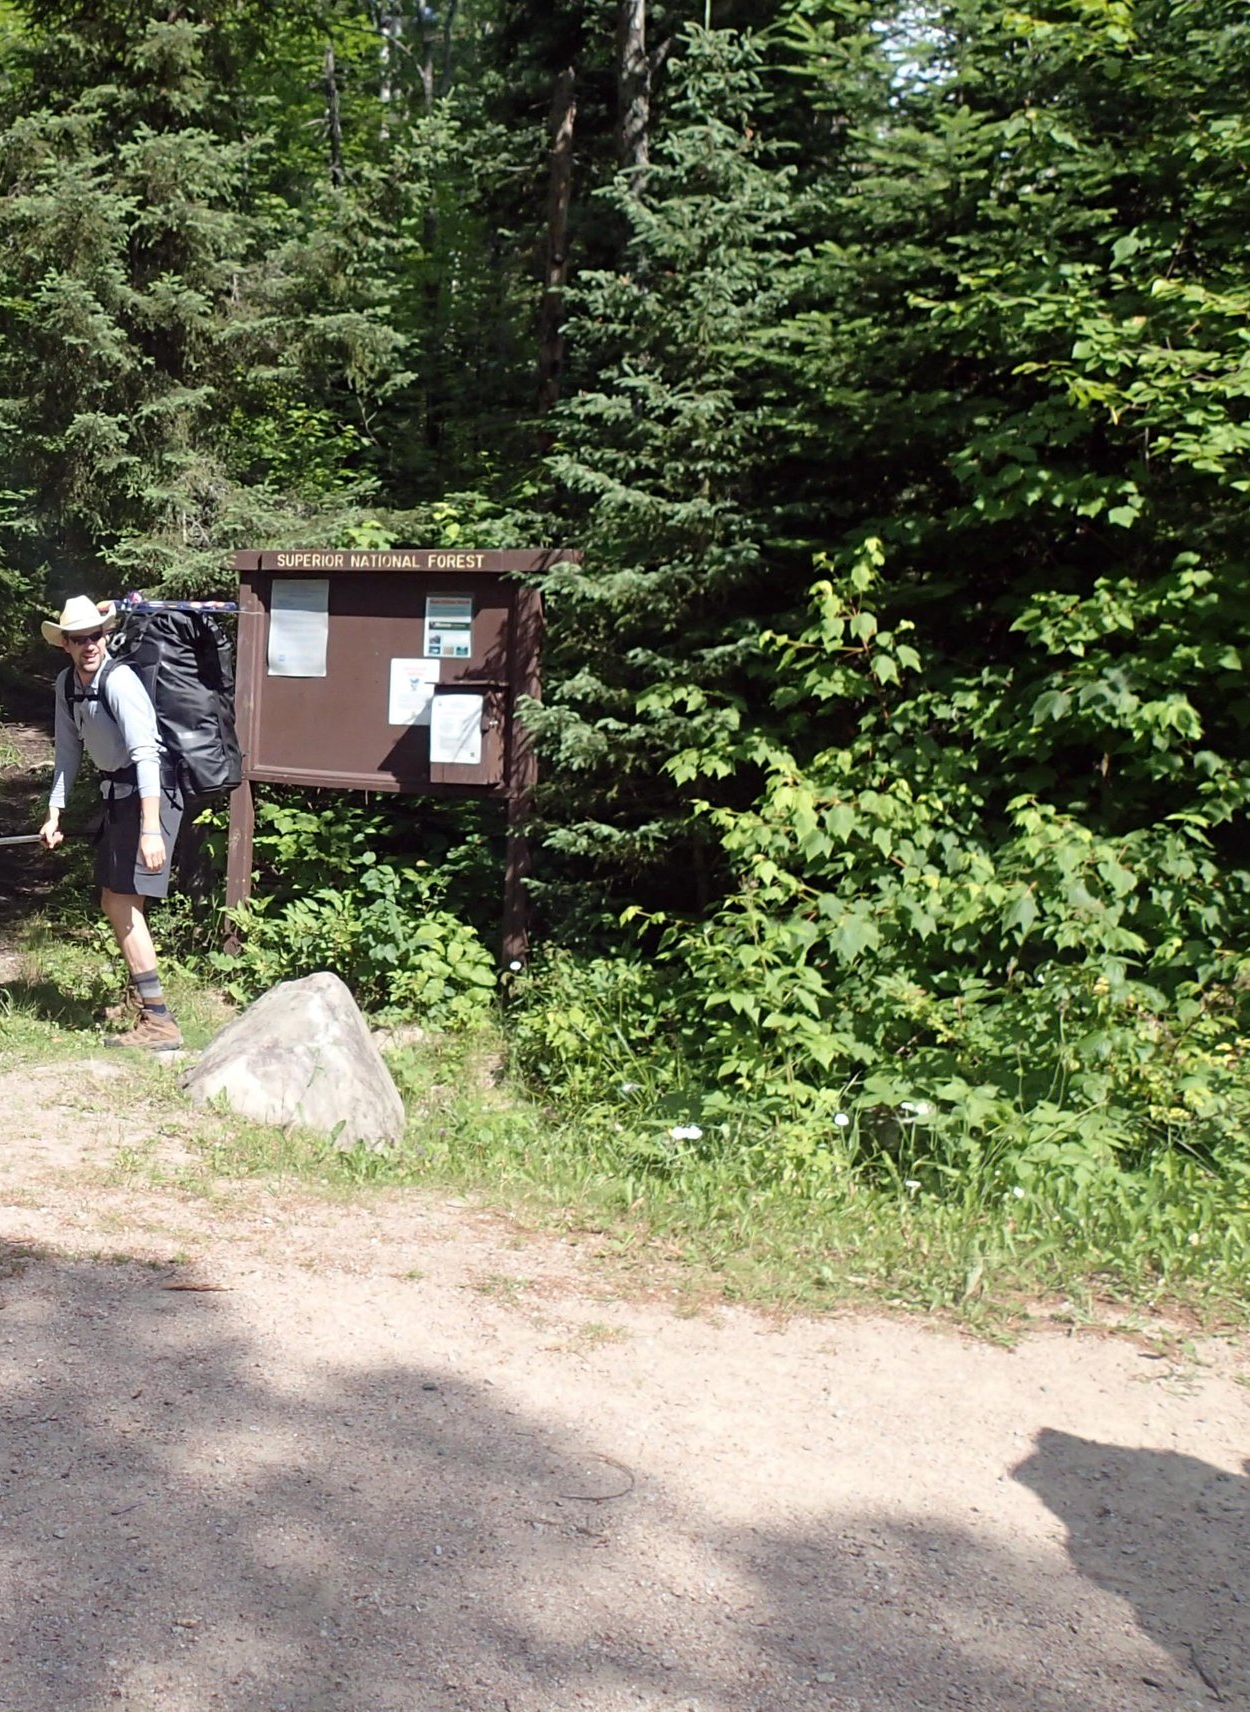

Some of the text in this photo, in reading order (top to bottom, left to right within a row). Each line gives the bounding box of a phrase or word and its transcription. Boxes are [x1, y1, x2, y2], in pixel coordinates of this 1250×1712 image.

[277, 554, 484, 568] SUPERIOR NATIONAL FOREST
